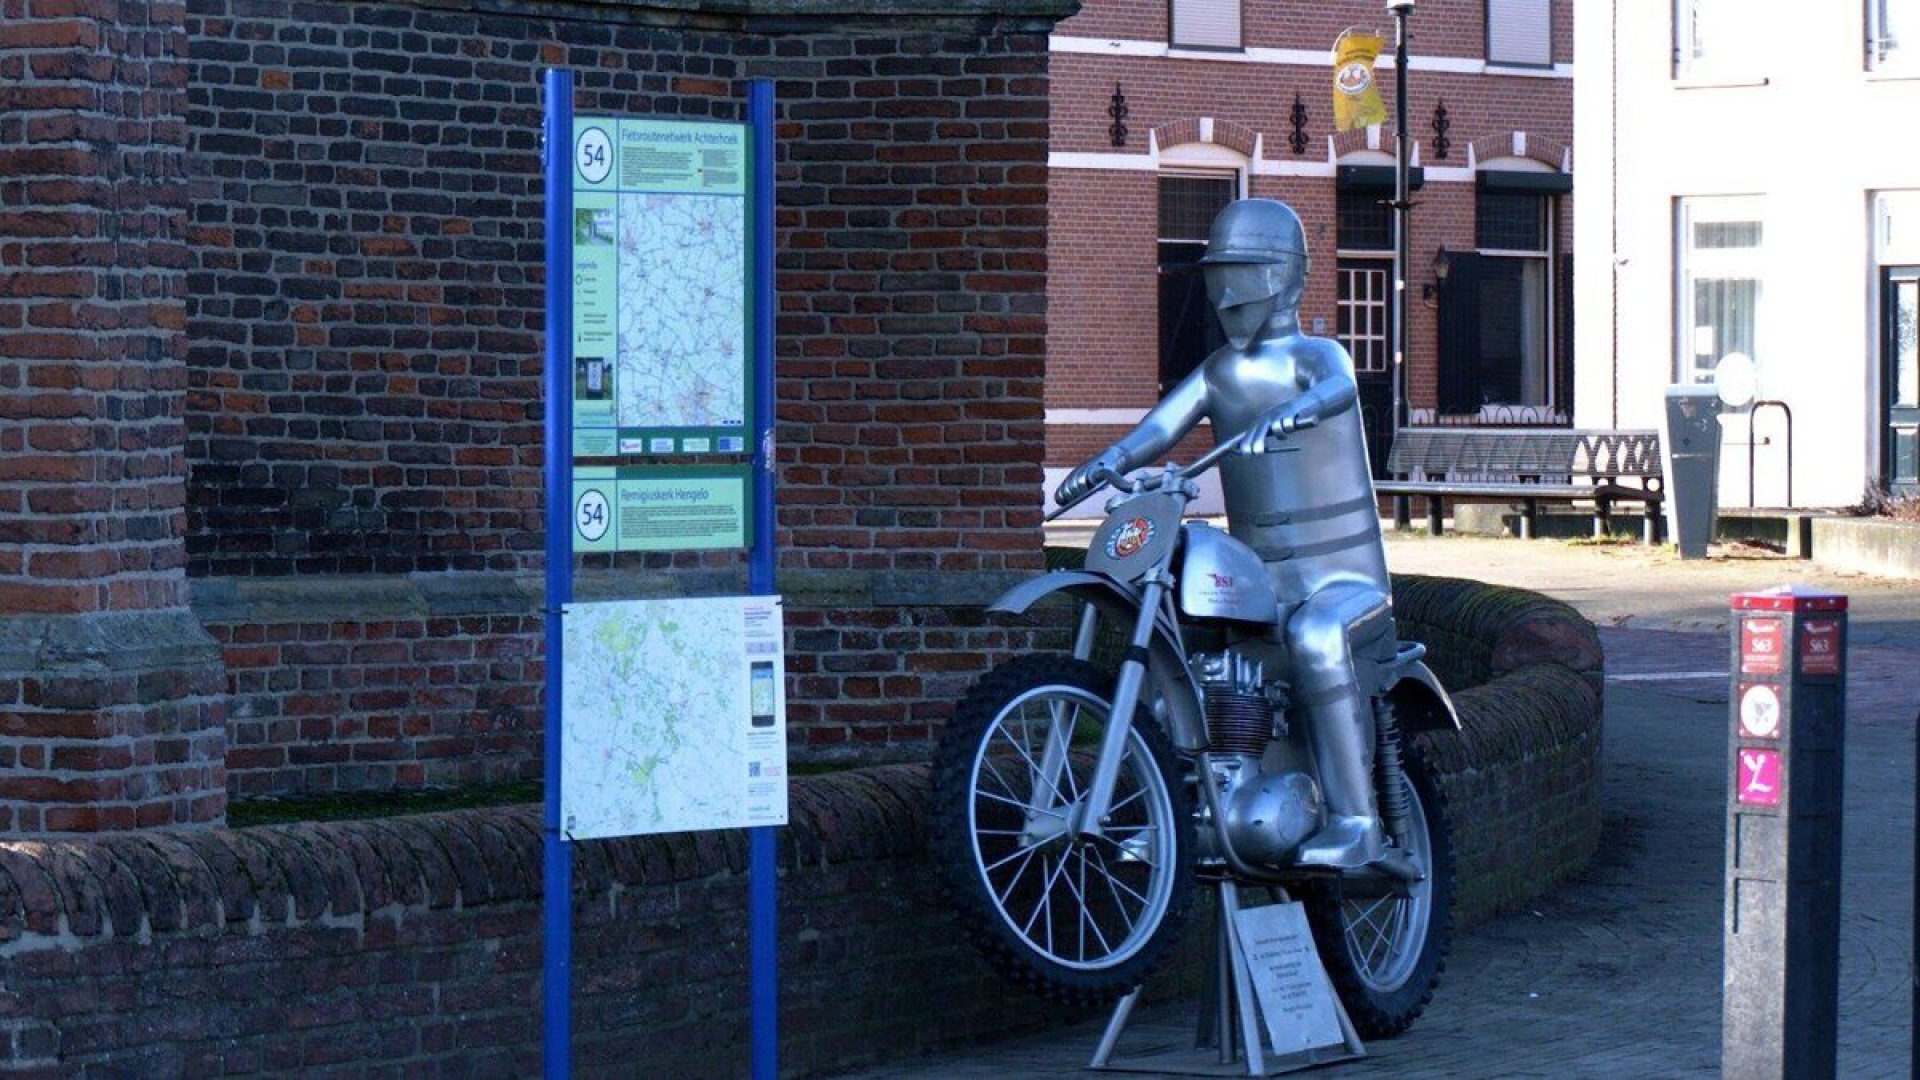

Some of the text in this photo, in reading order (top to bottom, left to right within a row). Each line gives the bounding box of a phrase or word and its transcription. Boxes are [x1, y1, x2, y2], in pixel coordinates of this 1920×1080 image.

[621, 127, 738, 145] Fietsroutenetwerk Achterhoek
[583, 143, 605, 167] 54
[620, 488, 709, 504] Remigiuskerk Hengelo
[582, 503, 603, 526] 54
